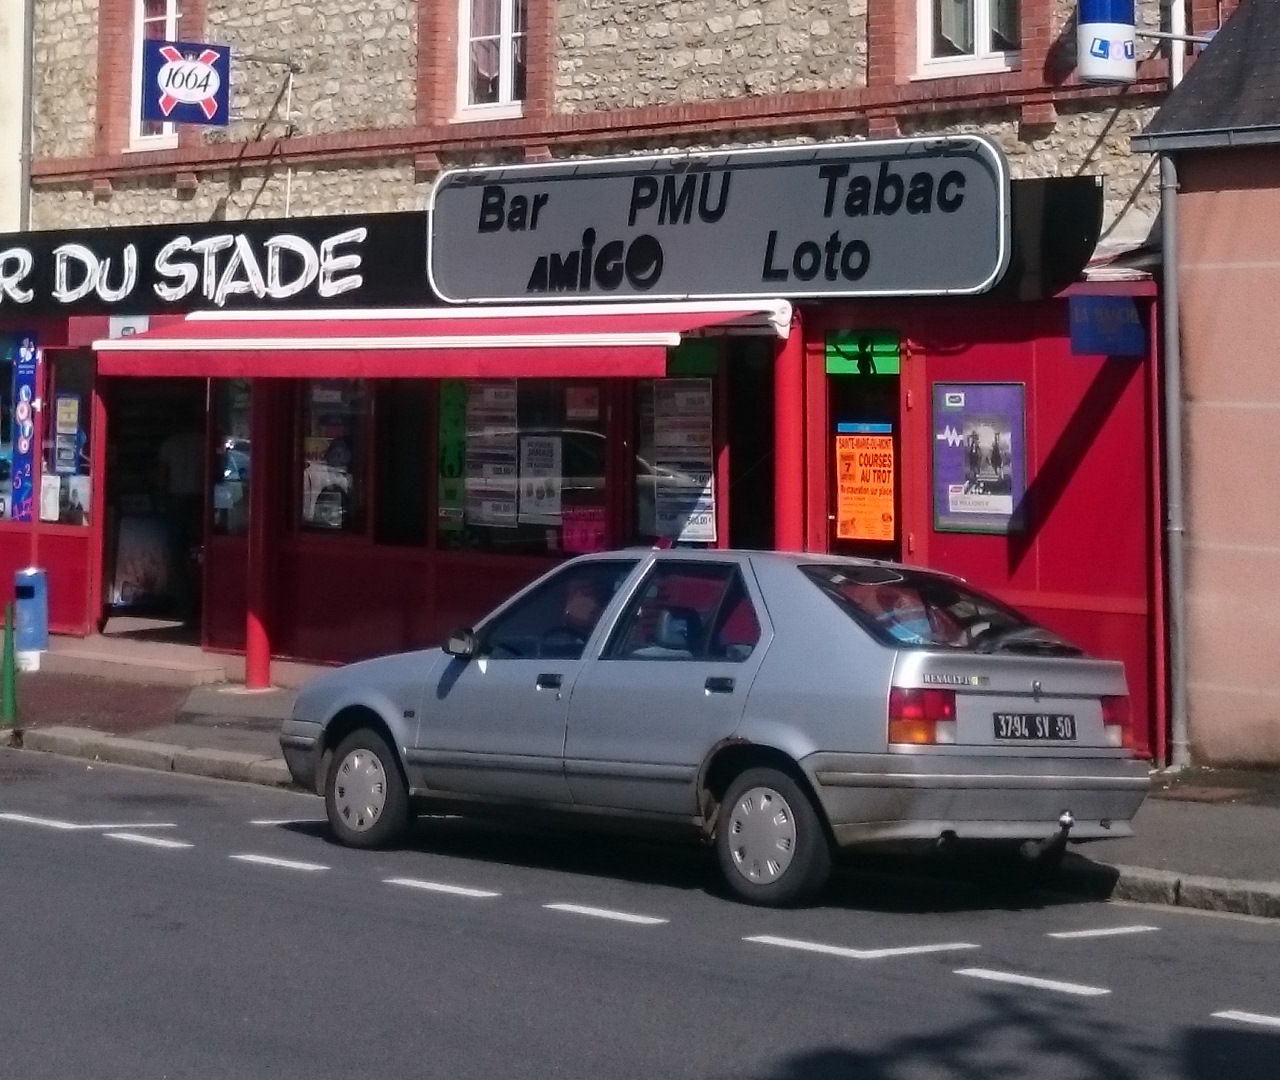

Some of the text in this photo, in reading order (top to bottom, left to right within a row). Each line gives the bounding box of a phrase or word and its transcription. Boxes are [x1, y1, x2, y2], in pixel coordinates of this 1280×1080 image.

[165, 65, 212, 93] 1664
[477, 161, 966, 233] Bar PMU Tabac
[51, 242, 138, 304] DU
[153, 227, 368, 308] STADE
[762, 230, 871, 283] Loto
[858, 452, 892, 468] COURSES
[860, 470, 871, 483] AU
[873, 470, 892, 484] TROT
[923, 674, 962, 684] RENAULT
[998, 715, 1072, 738] 3794 SV 50
